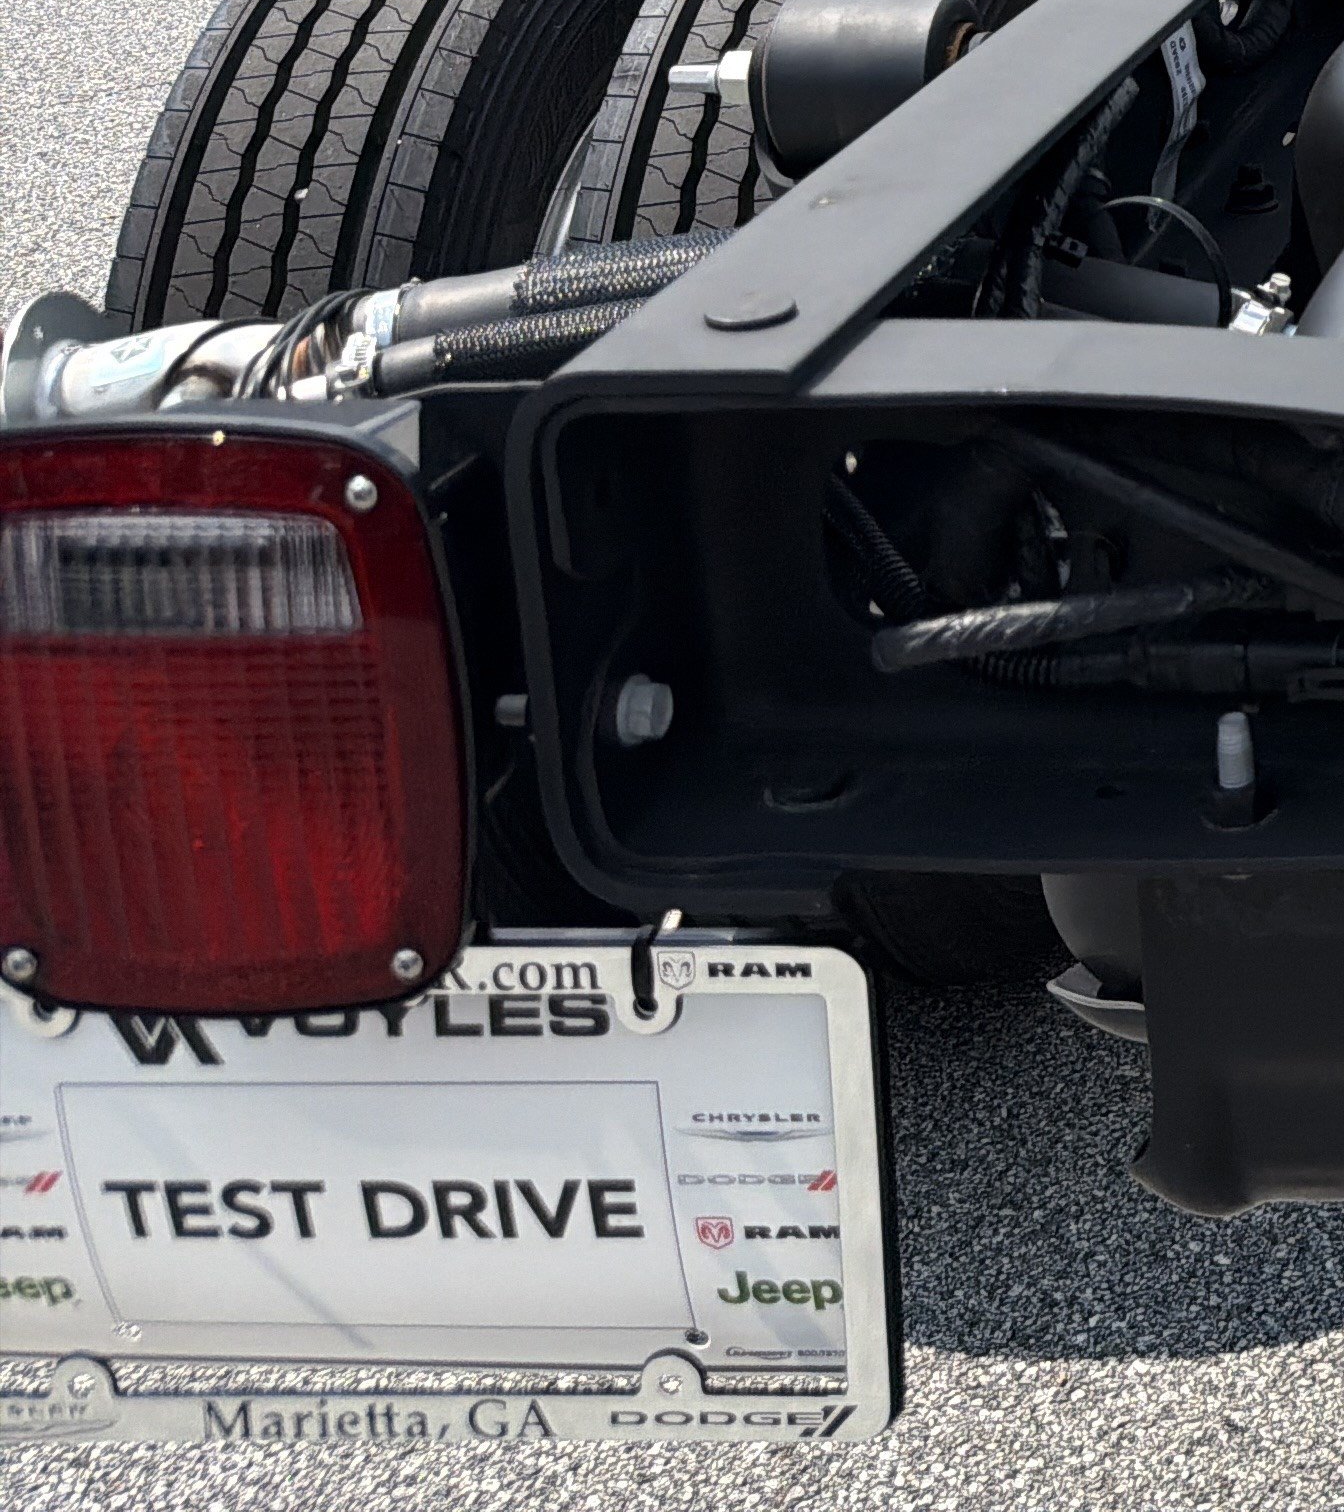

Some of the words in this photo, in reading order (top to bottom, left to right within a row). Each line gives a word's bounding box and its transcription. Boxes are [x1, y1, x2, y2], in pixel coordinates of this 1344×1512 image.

[707, 962, 813, 978] RAM
[691, 1113, 821, 1123] CHRYSLER
[677, 1174, 821, 1185] DODGE
[103, 1178, 325, 1240] TEST
[358, 1178, 646, 1240] DRIVE
[0, 1226, 67, 1239] AM
[743, 1225, 840, 1239] RAM
[717, 1270, 843, 1311] Jeep
[203, 1398, 451, 1439] Marietta,
[468, 1398, 559, 1439] GA
[611, 1411, 825, 1426] DODGE
